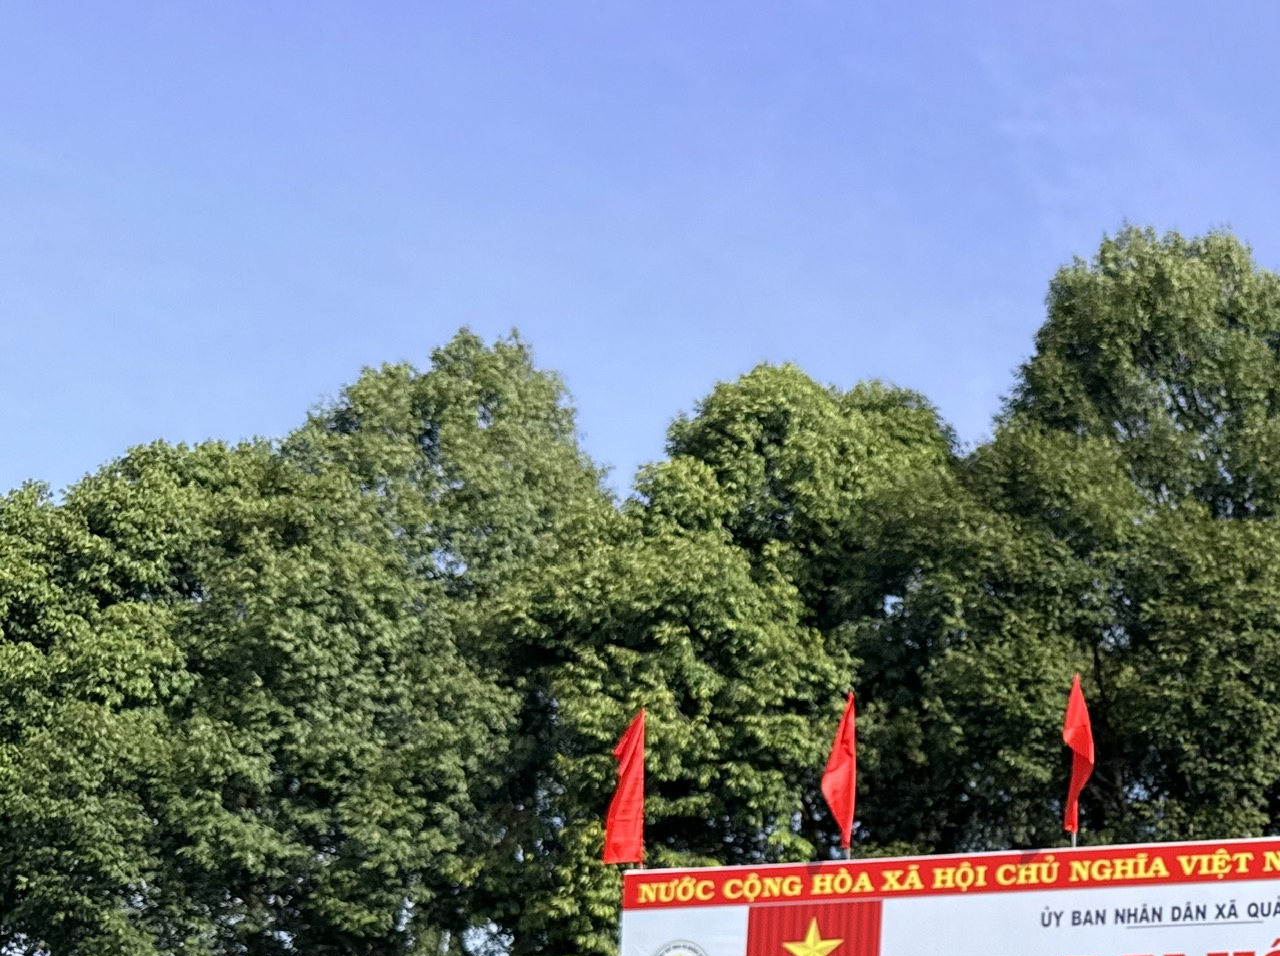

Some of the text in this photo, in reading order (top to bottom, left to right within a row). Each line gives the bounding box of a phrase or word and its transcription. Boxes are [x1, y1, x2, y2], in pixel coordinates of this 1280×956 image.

[638, 876, 715, 903] NƯỚC
[722, 872, 804, 902] CỘNG
[810, 867, 875, 896] HÒA
[880, 864, 925, 892] XÃ
[931, 861, 989, 892] HỘI
[995, 854, 1060, 886] CHỦ
[1068, 853, 1170, 882] NGHĨA
[1176, 847, 1255, 880] VIỆT
[1040, 905, 1064, 928] ỦY
[1071, 910, 1107, 927] BAN
[1114, 902, 1163, 925] NHÂN
[1170, 901, 1207, 922] DÂN
[1214, 899, 1239, 920] XÃ
